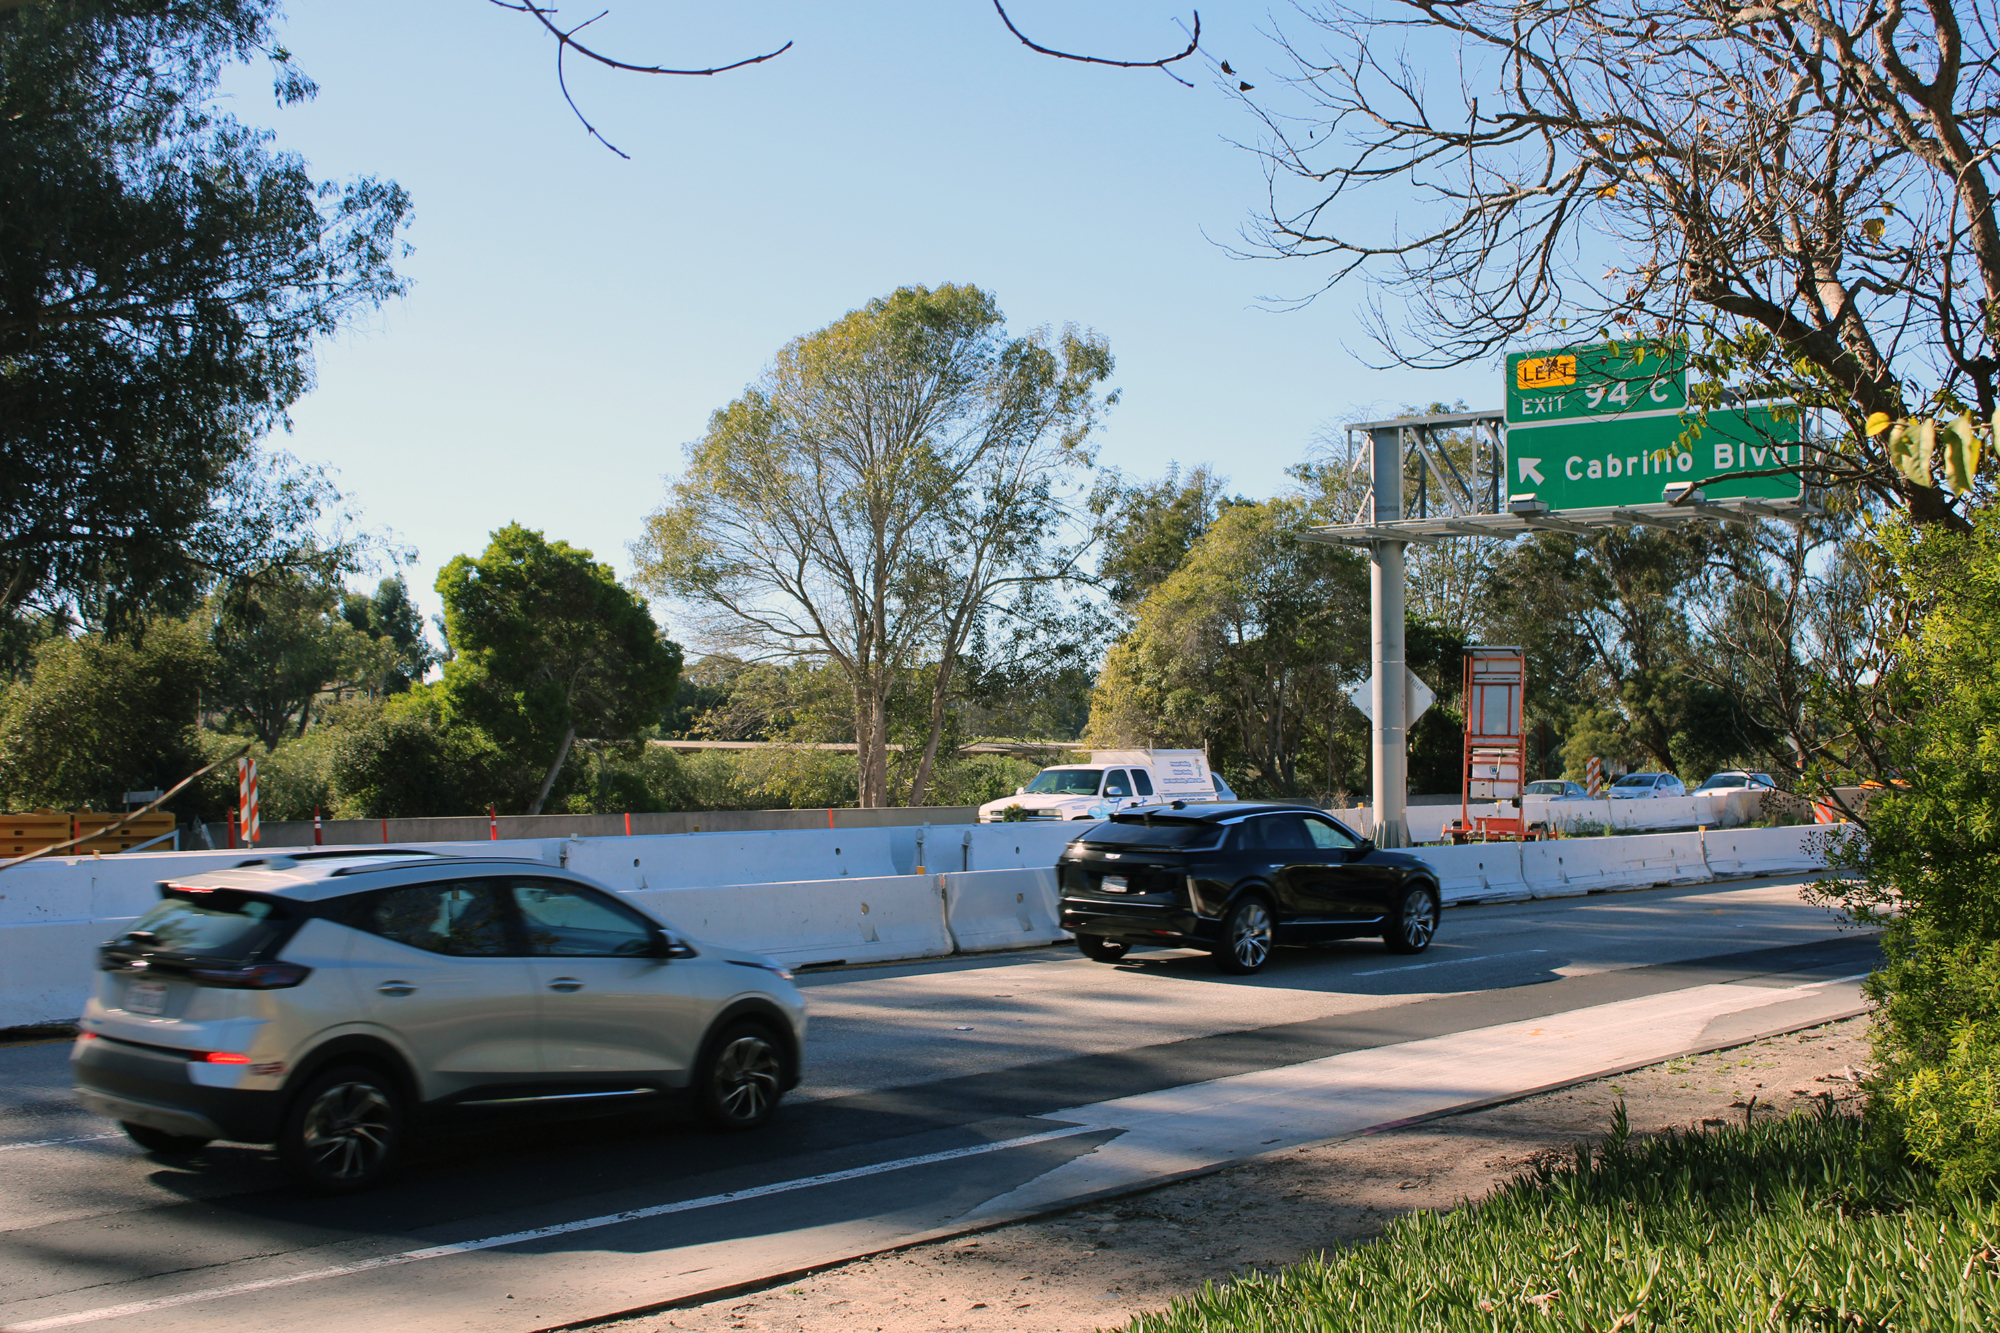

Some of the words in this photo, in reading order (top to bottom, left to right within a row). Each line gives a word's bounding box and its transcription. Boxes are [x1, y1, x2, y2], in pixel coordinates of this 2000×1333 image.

[1522, 395, 1565, 415] EXIT
[1585, 383, 1628, 408] 94
[1649, 378, 1669, 403] C
[1565, 449, 1693, 481] Cabrillo
[1714, 439, 1789, 469] Blvd
